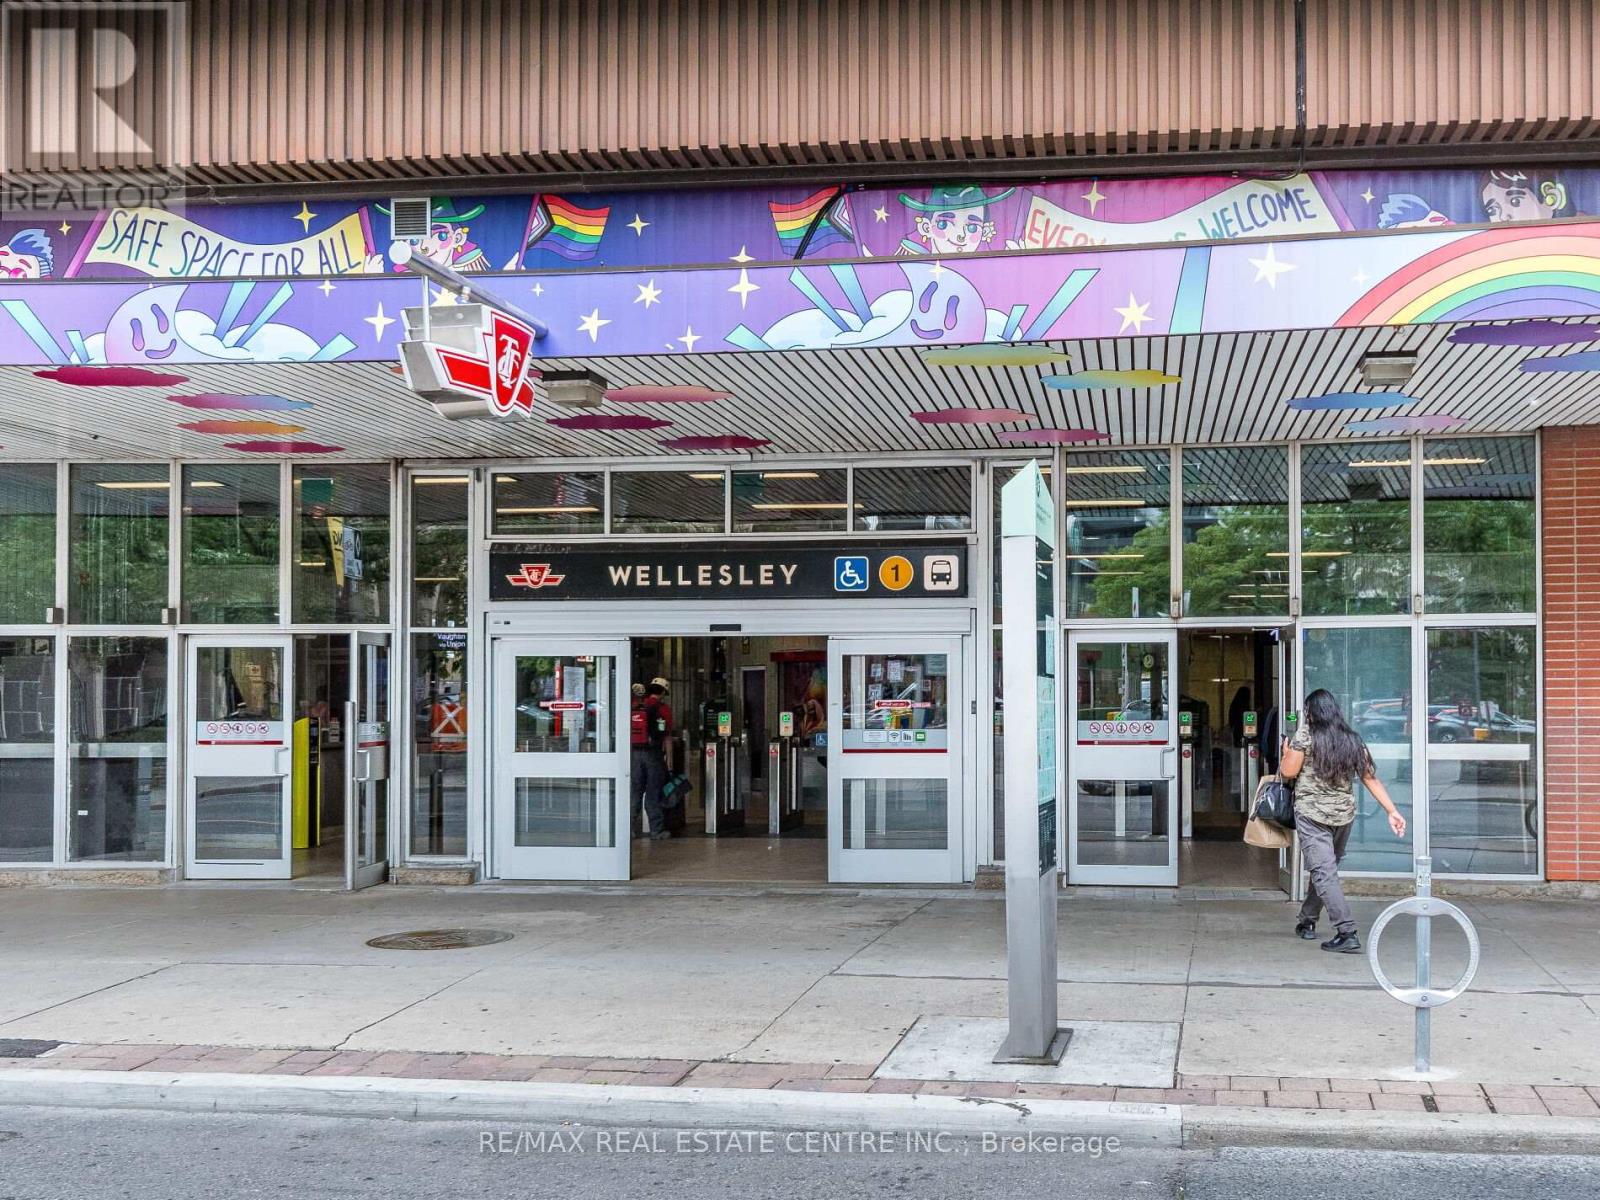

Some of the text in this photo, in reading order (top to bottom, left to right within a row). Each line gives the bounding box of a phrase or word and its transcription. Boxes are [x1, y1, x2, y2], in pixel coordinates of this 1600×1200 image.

[1197, 187, 1318, 240] WELCOME
[97, 209, 169, 268] SAFE
[318, 229, 362, 274] ALL
[608, 564, 903, 586] WELLESLEY 1
